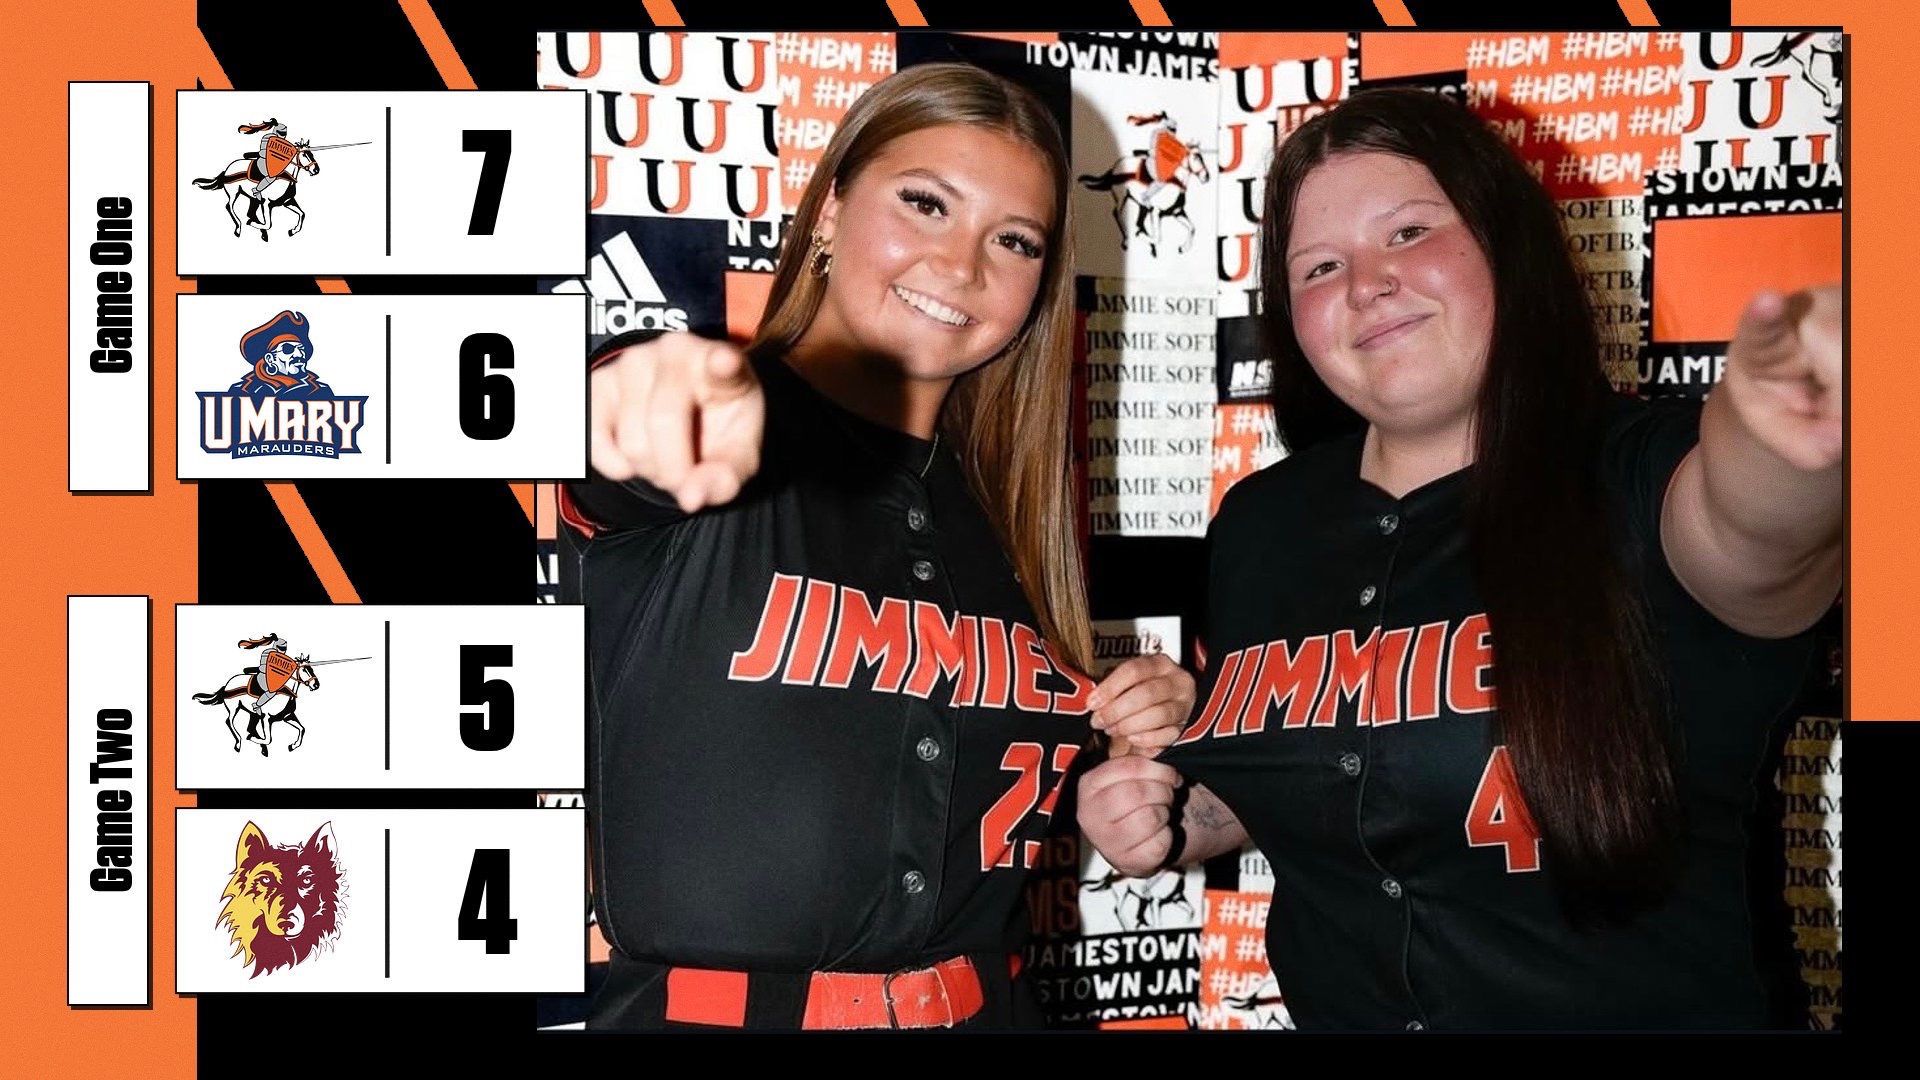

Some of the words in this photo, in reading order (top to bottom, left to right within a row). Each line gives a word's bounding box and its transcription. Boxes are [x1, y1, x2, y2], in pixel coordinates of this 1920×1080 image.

[716, 36, 771, 93] U
[776, 32, 862, 74] #HBM
[1125, 49, 1220, 84] JAMES
[1466, 35, 1550, 70] #HBM
[1561, 32, 1649, 61] #HBM
[1509, 70, 1597, 106] #HBM
[1732, 75, 1791, 130] U
[596, 90, 655, 148] U
[676, 96, 732, 154] U
[1532, 110, 1619, 144] #HBM
[1555, 150, 1642, 185] #HBM
[639, 157, 697, 215] U
[719, 163, 775, 220] U
[1086, 331, 1160, 354] JIMMIE
[1087, 364, 1160, 388] JIMMIE
[1087, 401, 1161, 425] JIMMIE
[1088, 437, 1162, 460] JIMMIE
[1089, 477, 1162, 501] JIMMIE
[1090, 511, 1162, 536] JIMMIE
[1464, 745, 1543, 873] 4
